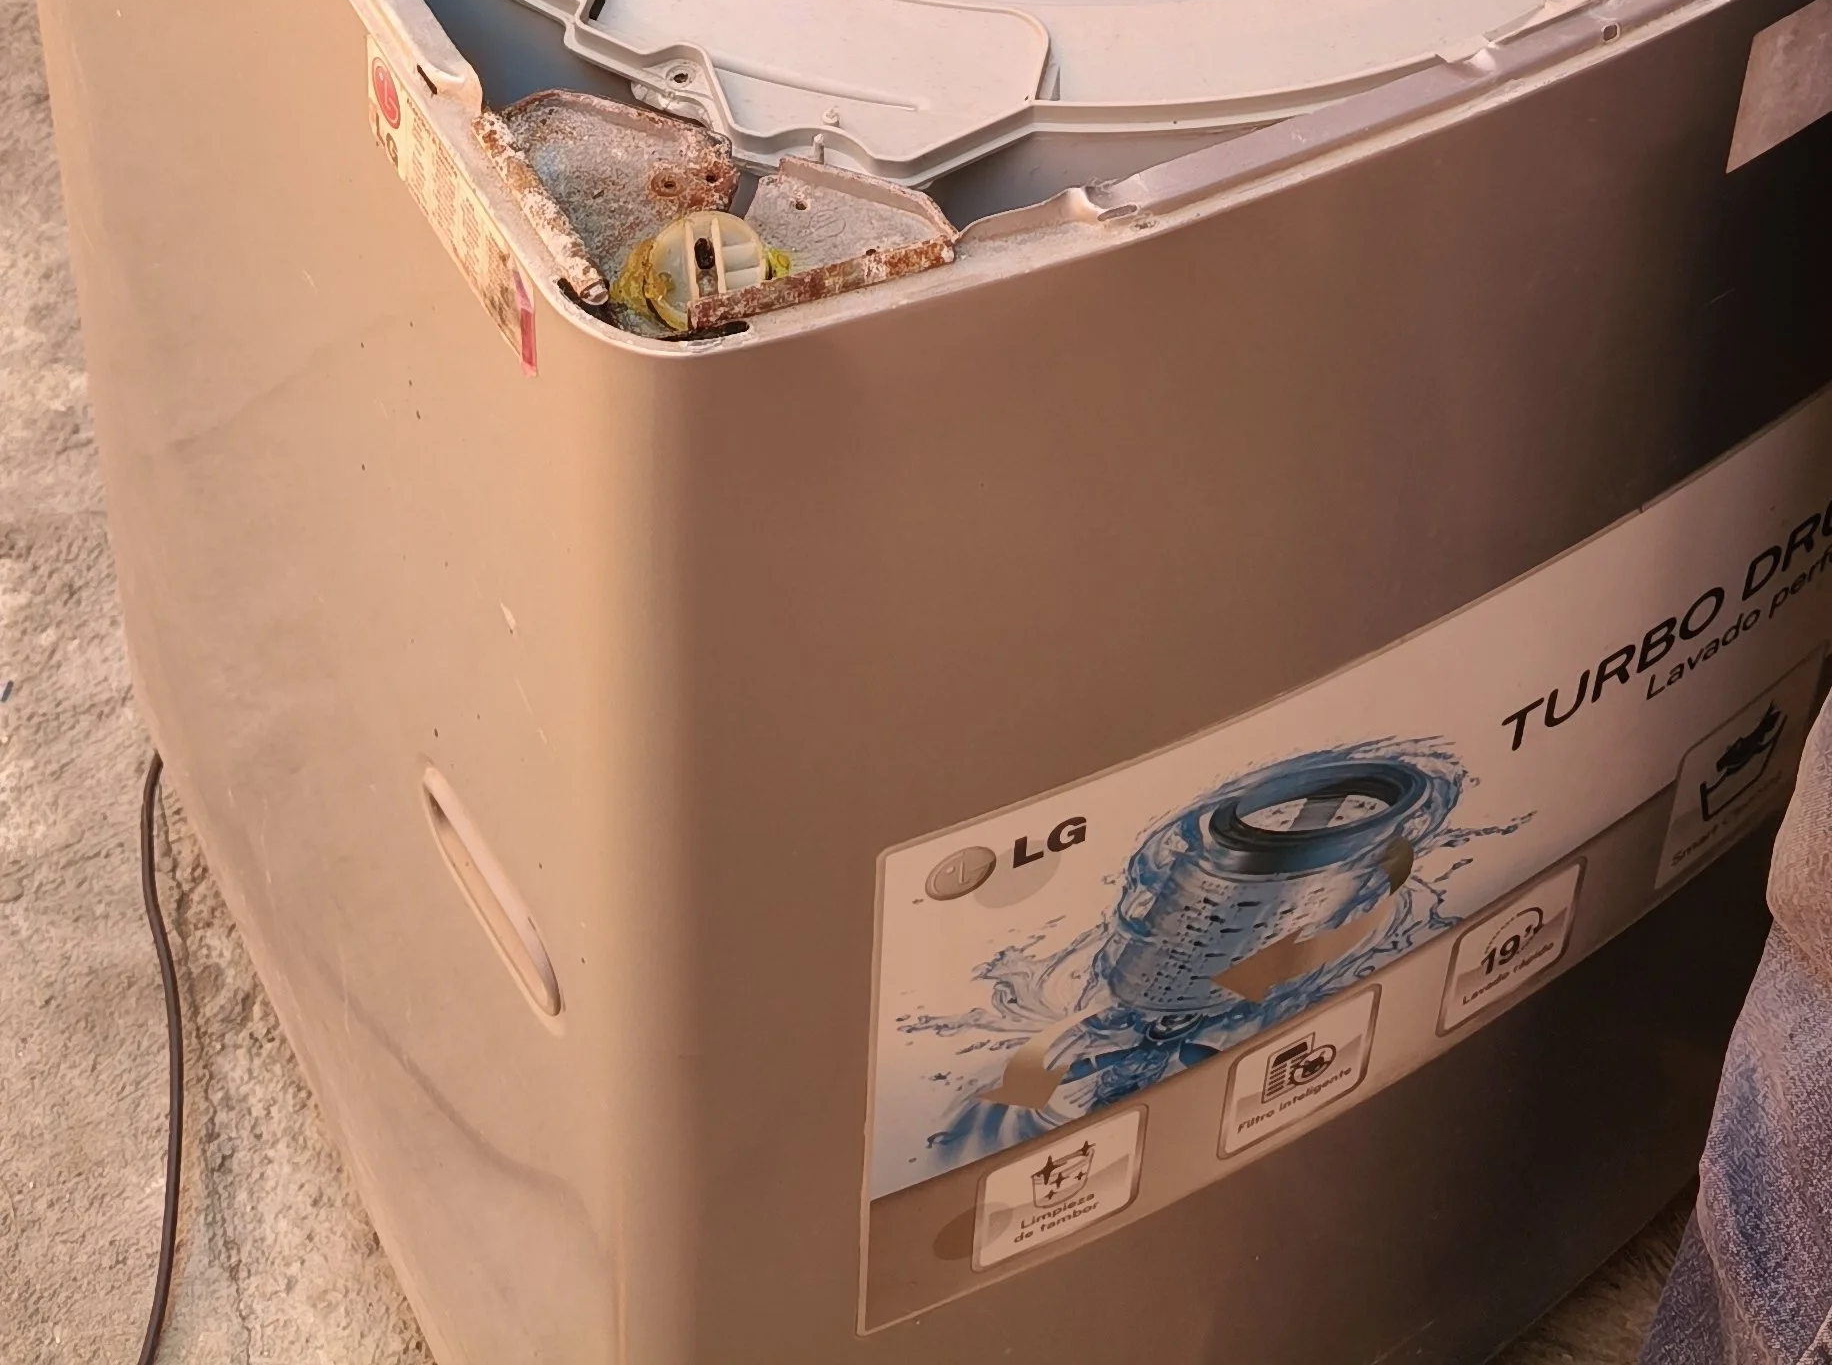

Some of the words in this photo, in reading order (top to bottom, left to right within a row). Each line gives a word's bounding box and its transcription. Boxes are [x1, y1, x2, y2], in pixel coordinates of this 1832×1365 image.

[373, 113, 400, 170] LG
[1501, 585, 1726, 753] TURBO
[1646, 609, 1761, 701] Lavado
[1012, 816, 1088, 869] LG
[1462, 971, 1510, 1006] Lavado
[1236, 1109, 1276, 1134] Filtro
[1278, 1066, 1353, 1112] inteligente
[1013, 1230, 1035, 1244] de
[1039, 1200, 1101, 1232] tambor
[1020, 1192, 1096, 1230] Limpieza
